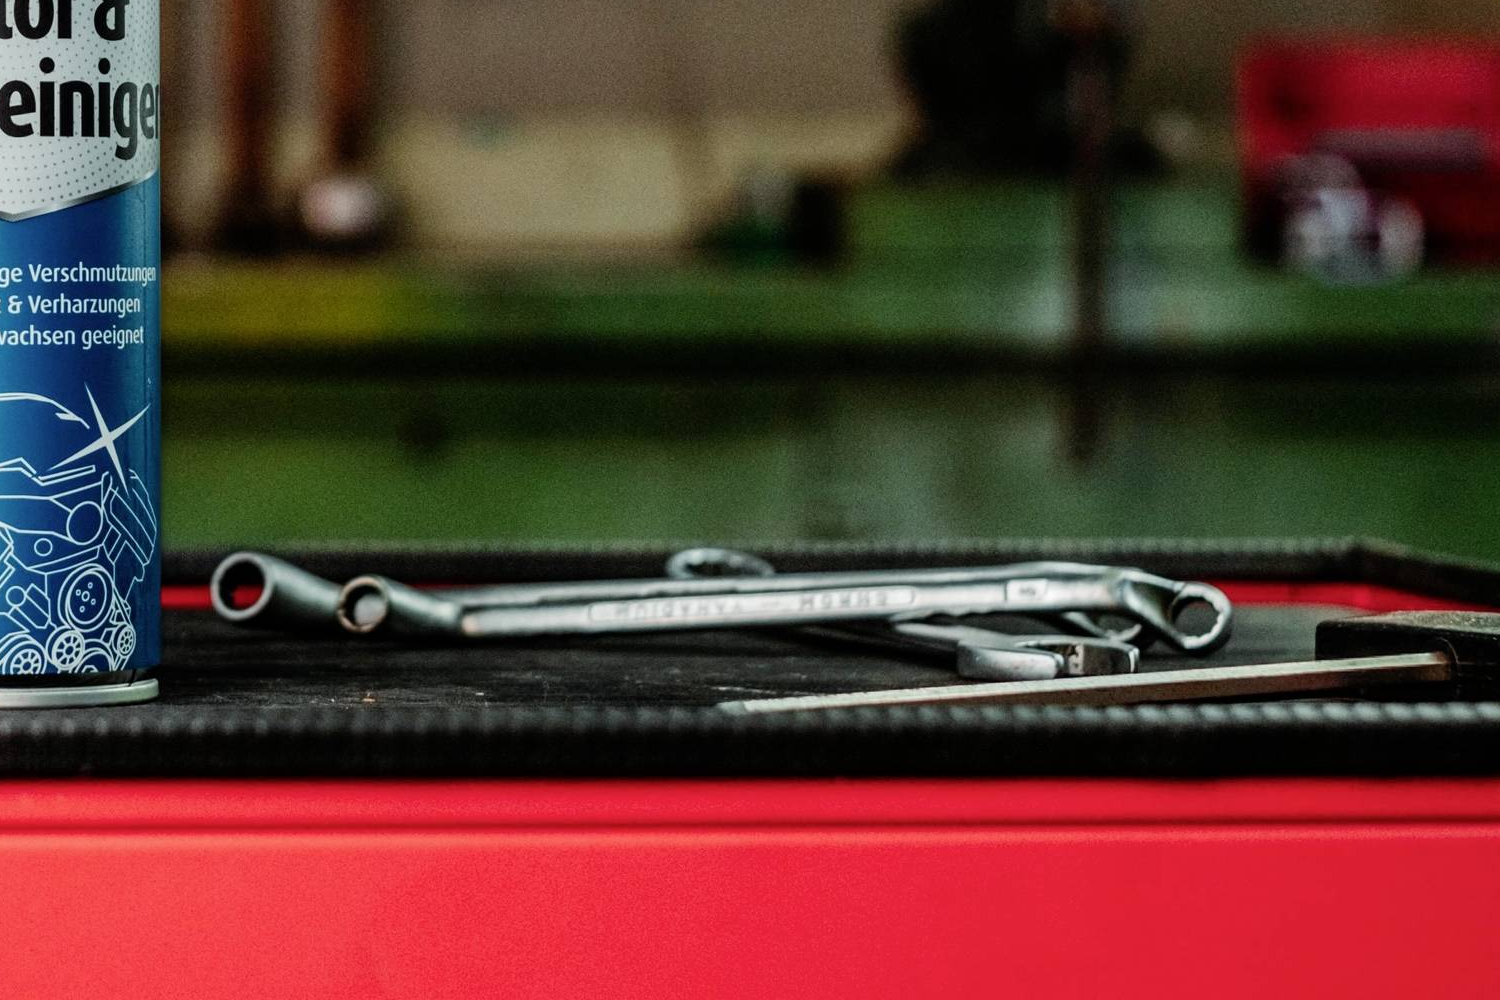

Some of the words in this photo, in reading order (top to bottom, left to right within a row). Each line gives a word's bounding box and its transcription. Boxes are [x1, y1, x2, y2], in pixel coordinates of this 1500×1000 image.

[28, 262, 156, 287] Verschmutzungen
[8, 295, 23, 314] &
[28, 293, 141, 318] Verharzungen
[82, 325, 144, 350] geeignet
